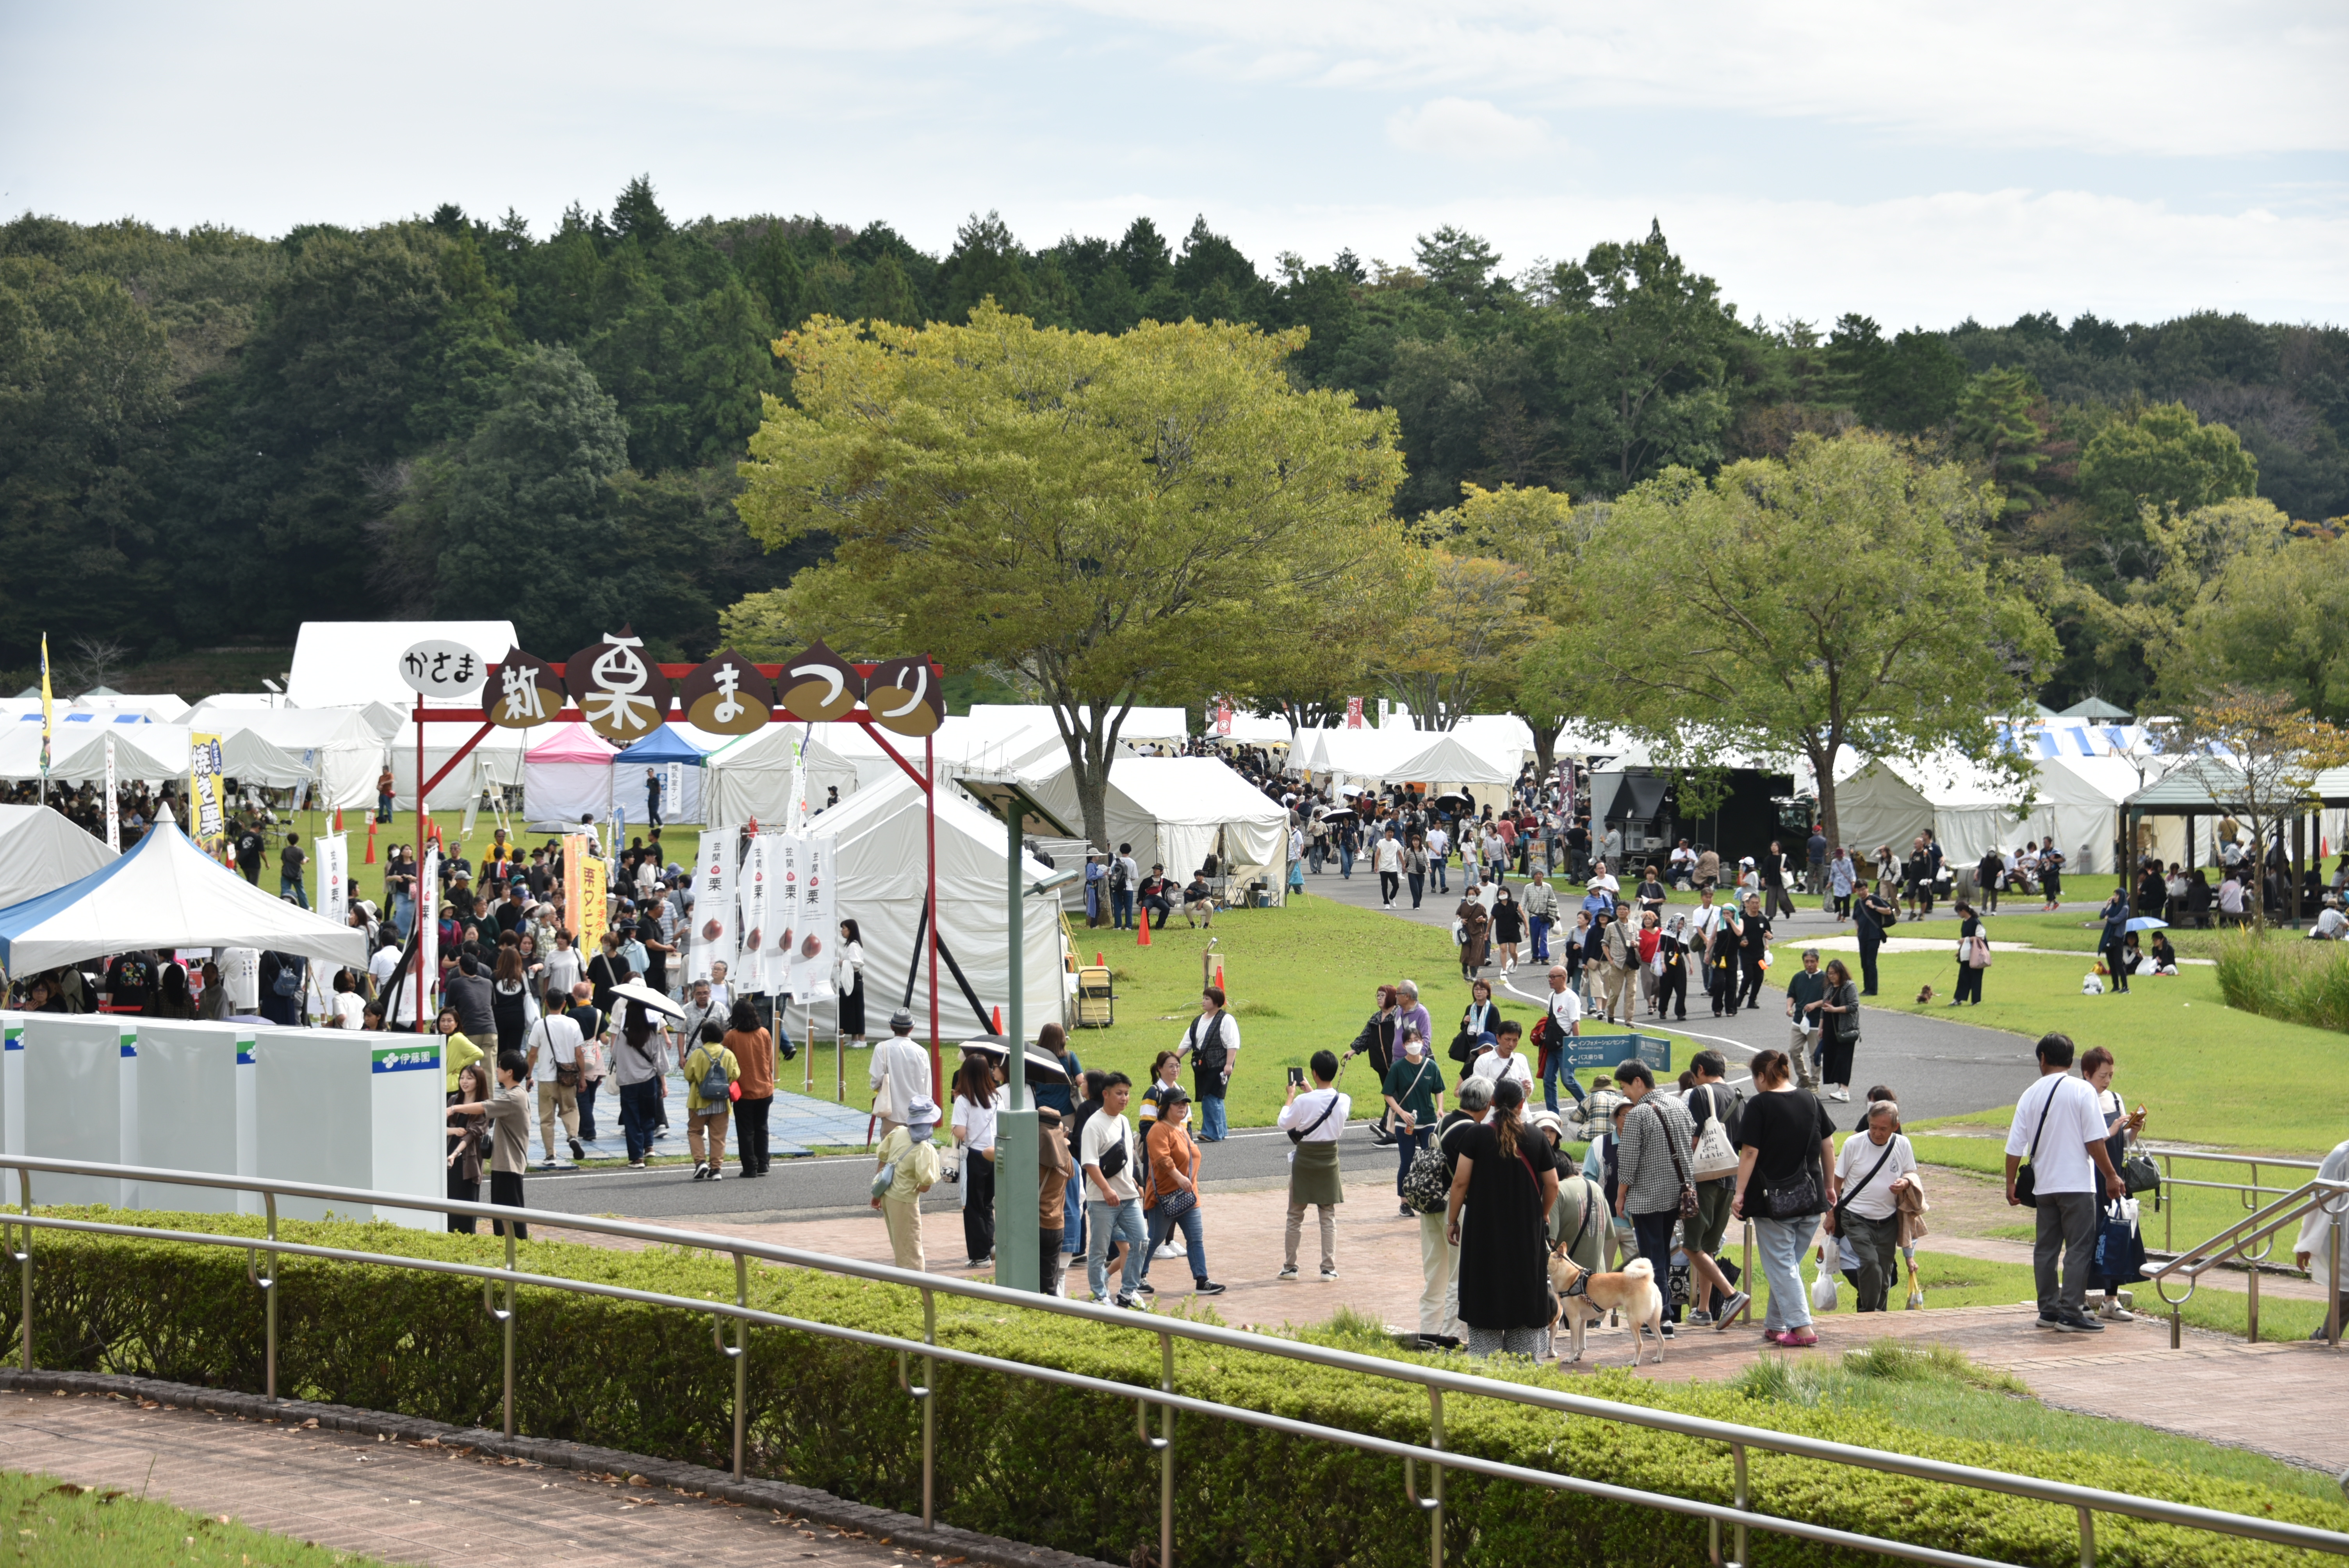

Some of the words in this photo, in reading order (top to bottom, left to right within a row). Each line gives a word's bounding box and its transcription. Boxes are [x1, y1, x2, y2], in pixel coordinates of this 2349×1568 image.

[405, 652, 474, 683] かさま
[212, 740, 221, 773] かさまの
[192, 743, 222, 836] 焼き栗
[400, 1051, 430, 1065] 伊藤園
